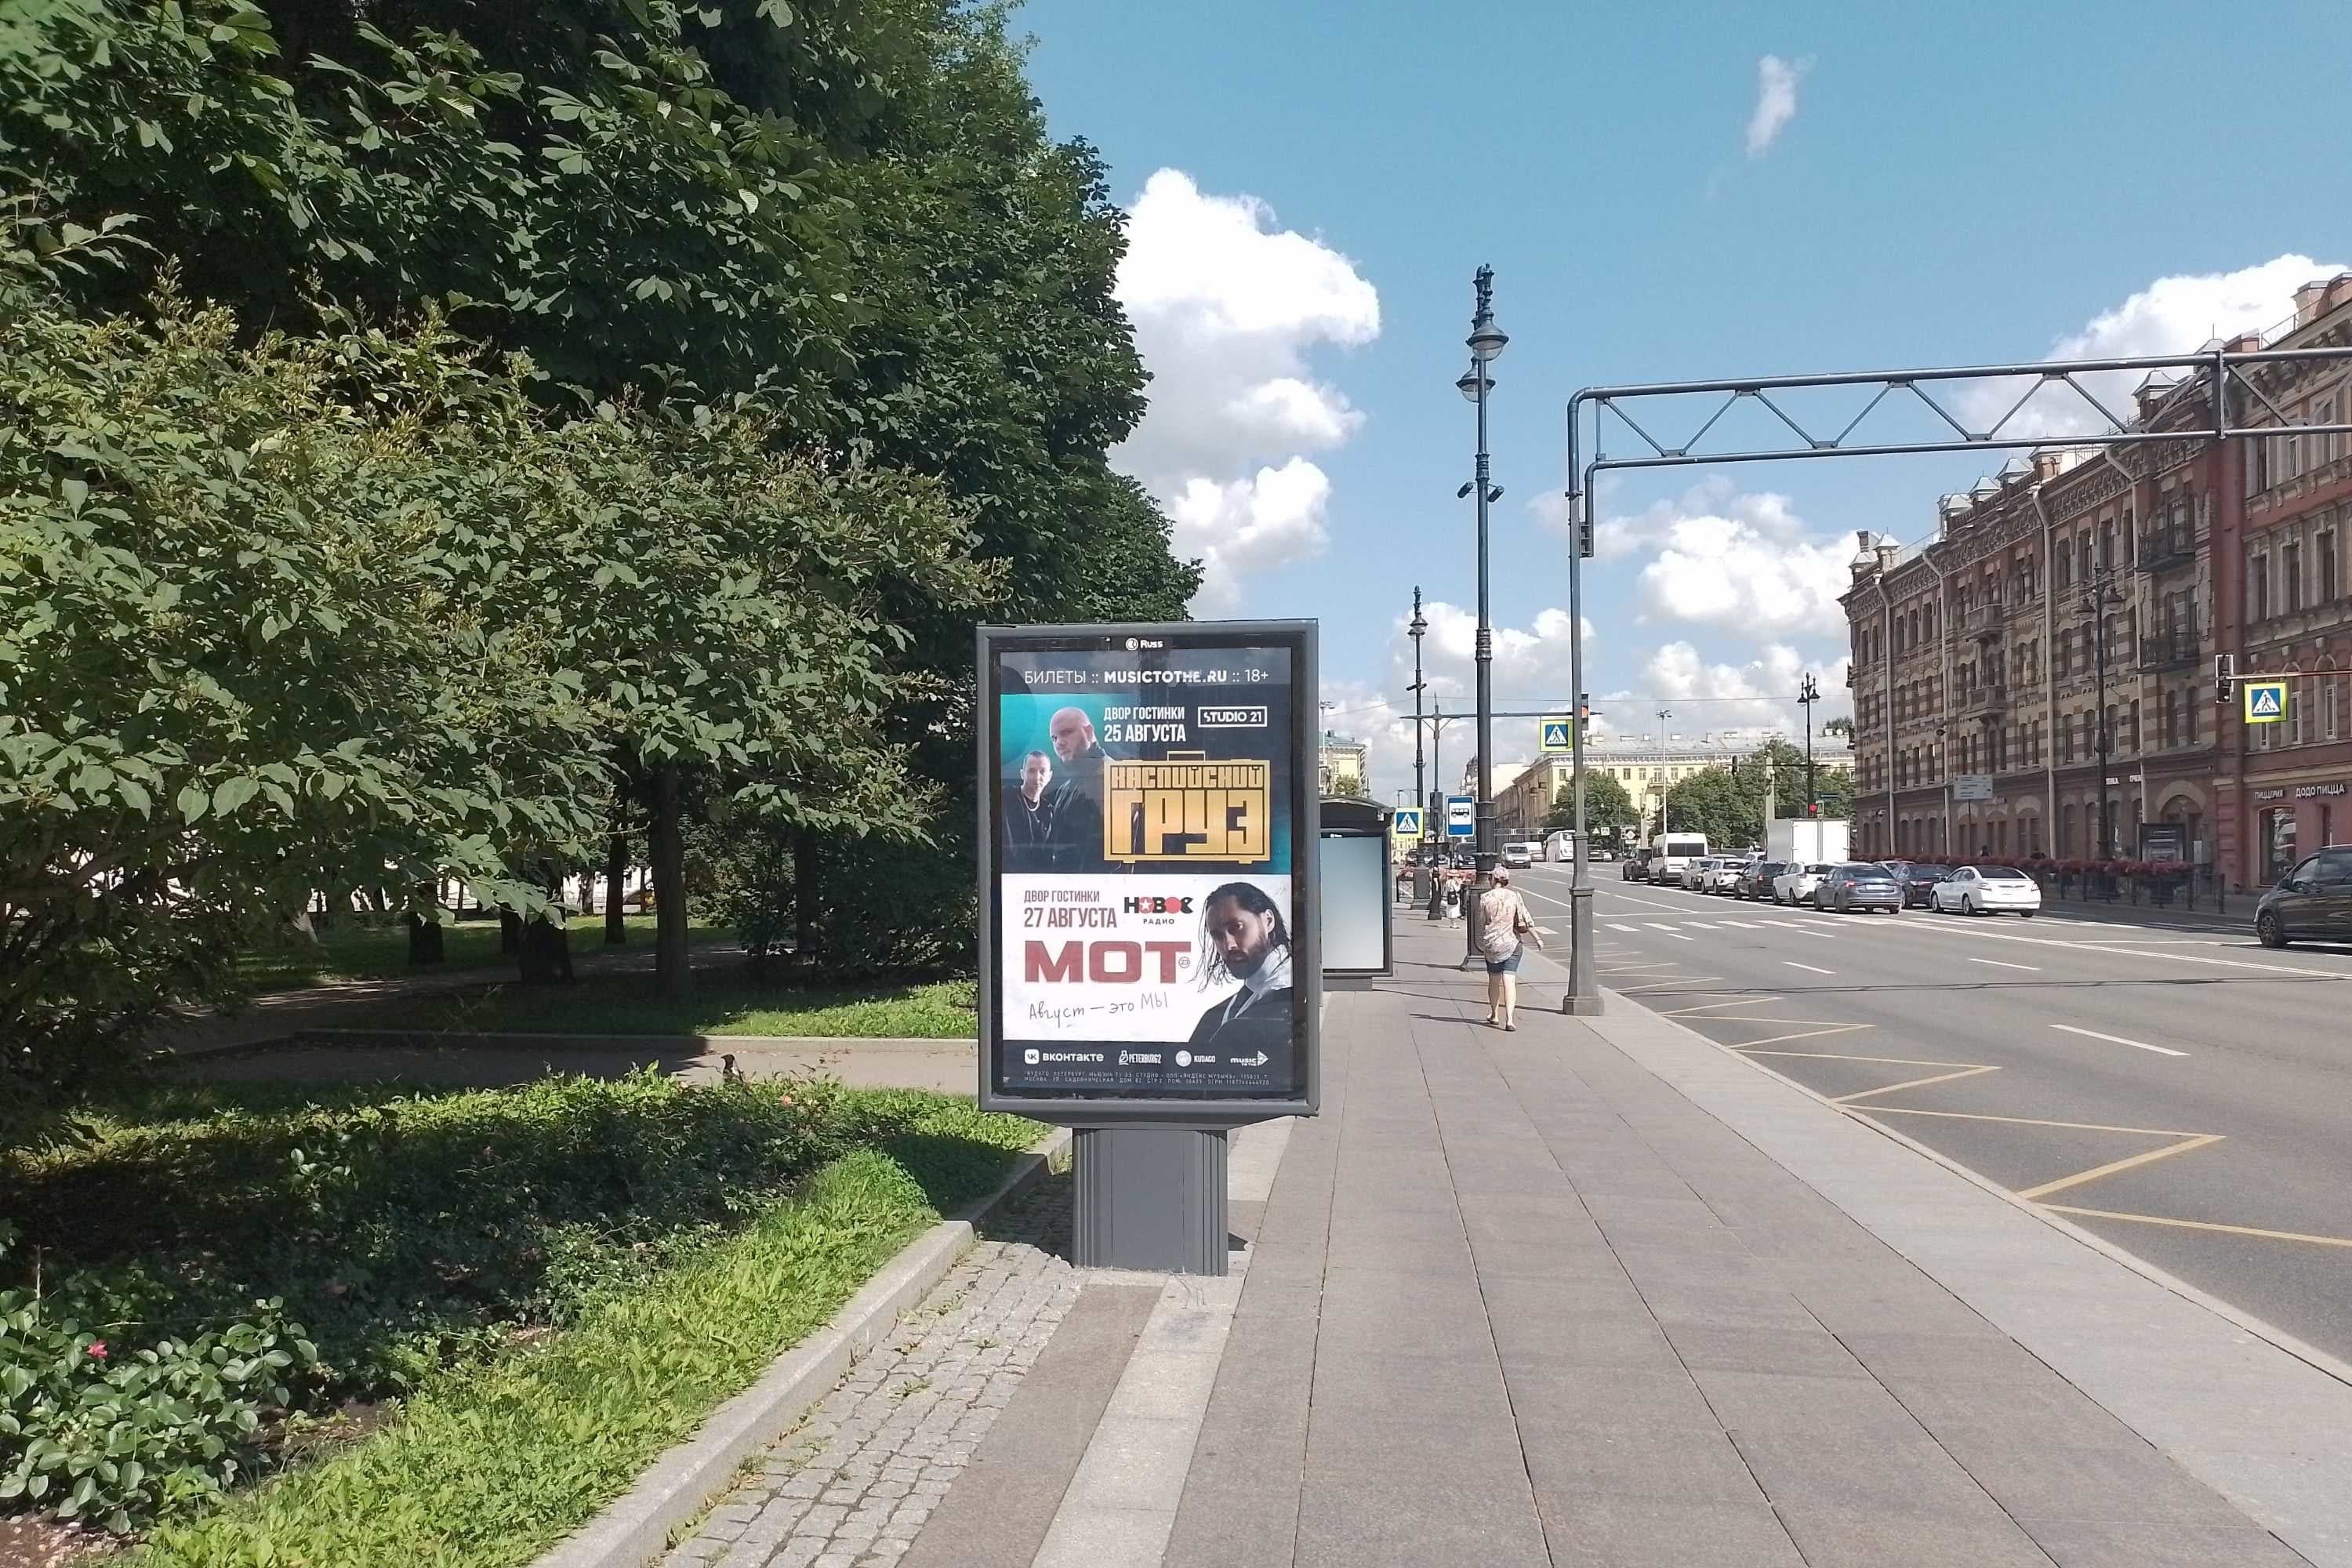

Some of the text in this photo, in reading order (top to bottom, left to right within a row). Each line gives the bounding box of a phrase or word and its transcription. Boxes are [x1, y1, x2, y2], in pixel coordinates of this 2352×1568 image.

[1025, 670, 1086, 684] БИЛЕТЫ
[1104, 670, 1227, 684] MUSICTOTHE.RU
[1245, 669, 1269, 682] 18+
[1103, 706, 1185, 721] ДВОР ГОСТИНКИ
[1203, 711, 1262, 723] STUDIO 21
[1104, 724, 1187, 742] 25 АВГУСТА
[2295, 784, 2345, 798] ДОДО ПИЦЦА
[1111, 789, 1263, 855] ГРУЗ
[1024, 890, 1100, 904] ДВОР ГОСТИНКИ
[1024, 907, 1118, 928] 27 АВГУСТА
[1025, 940, 1192, 984] МОТ
[1029, 1000, 1085, 1029] Август
[1109, 1002, 1134, 1014] это
